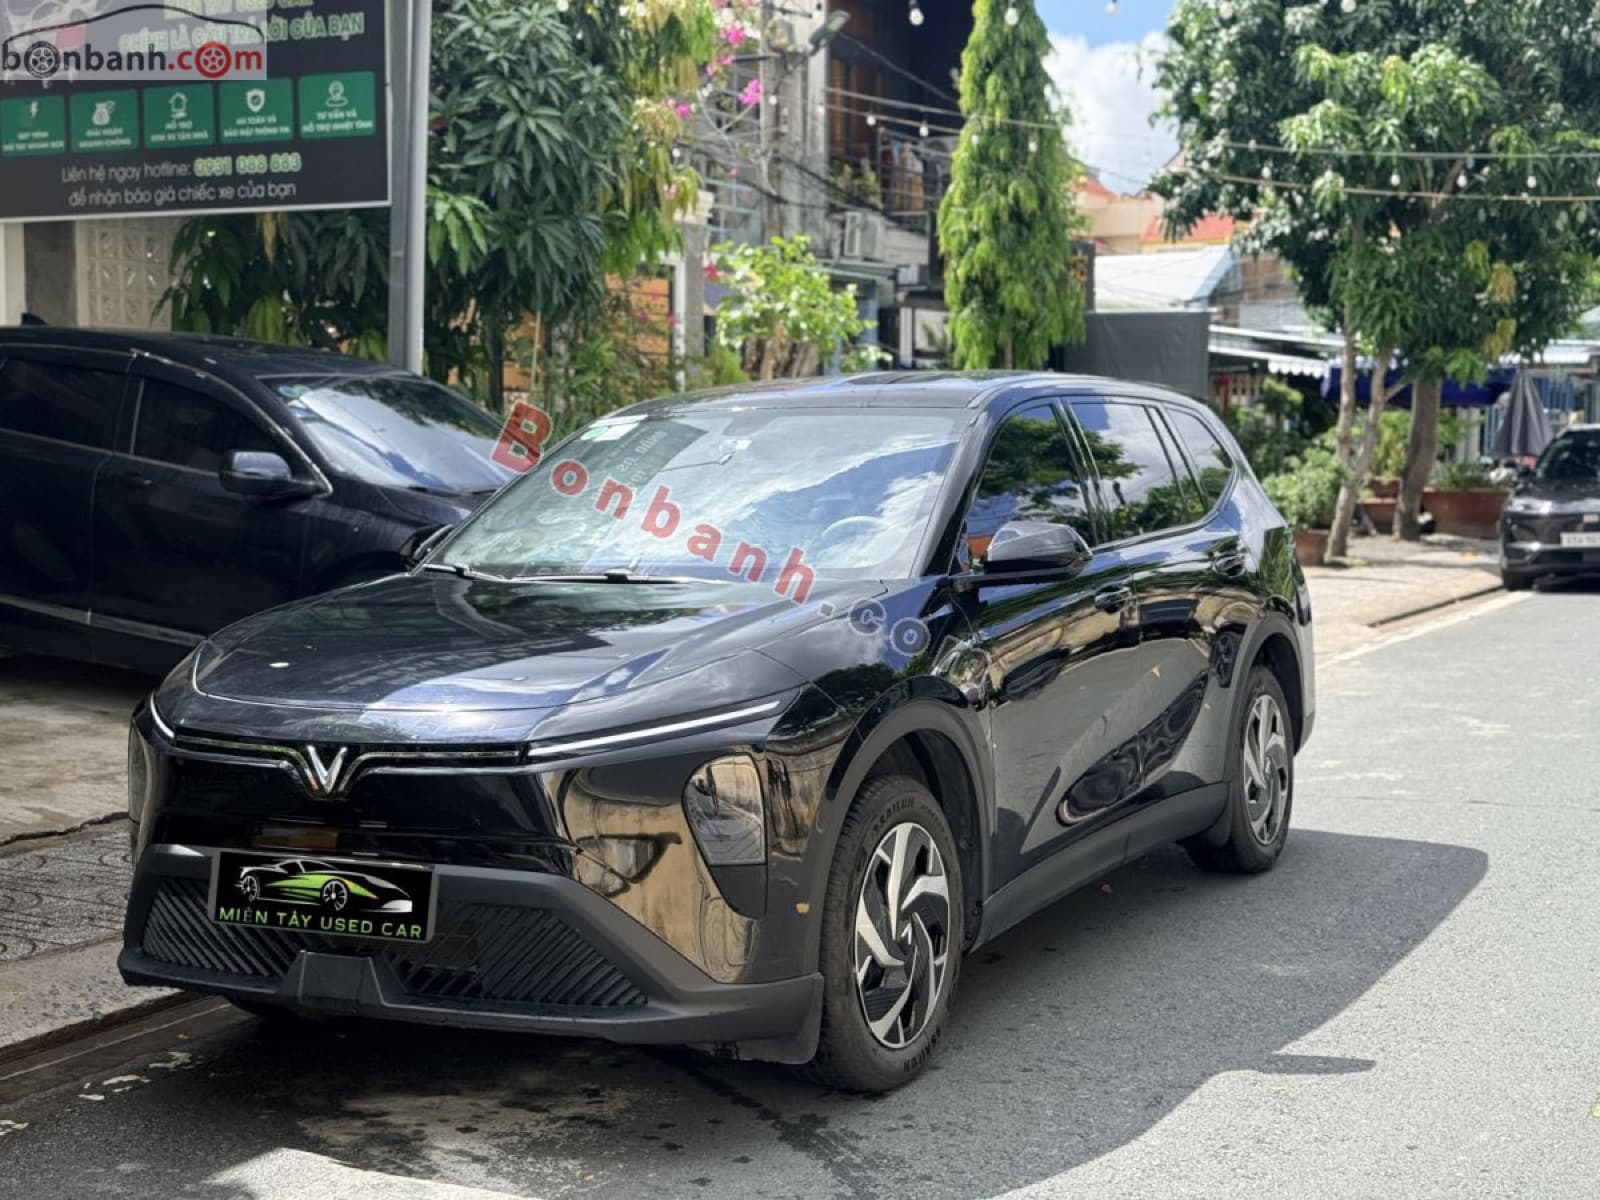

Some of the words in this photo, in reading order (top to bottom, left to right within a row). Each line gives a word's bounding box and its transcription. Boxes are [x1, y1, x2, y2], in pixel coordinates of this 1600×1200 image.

[108, 165, 141, 185] ngay
[218, 186, 235, 200] xe
[237, 180, 265, 199] của
[267, 181, 297, 201] bạn
[320, 915, 373, 934] USED
[381, 922, 422, 939] CAR
